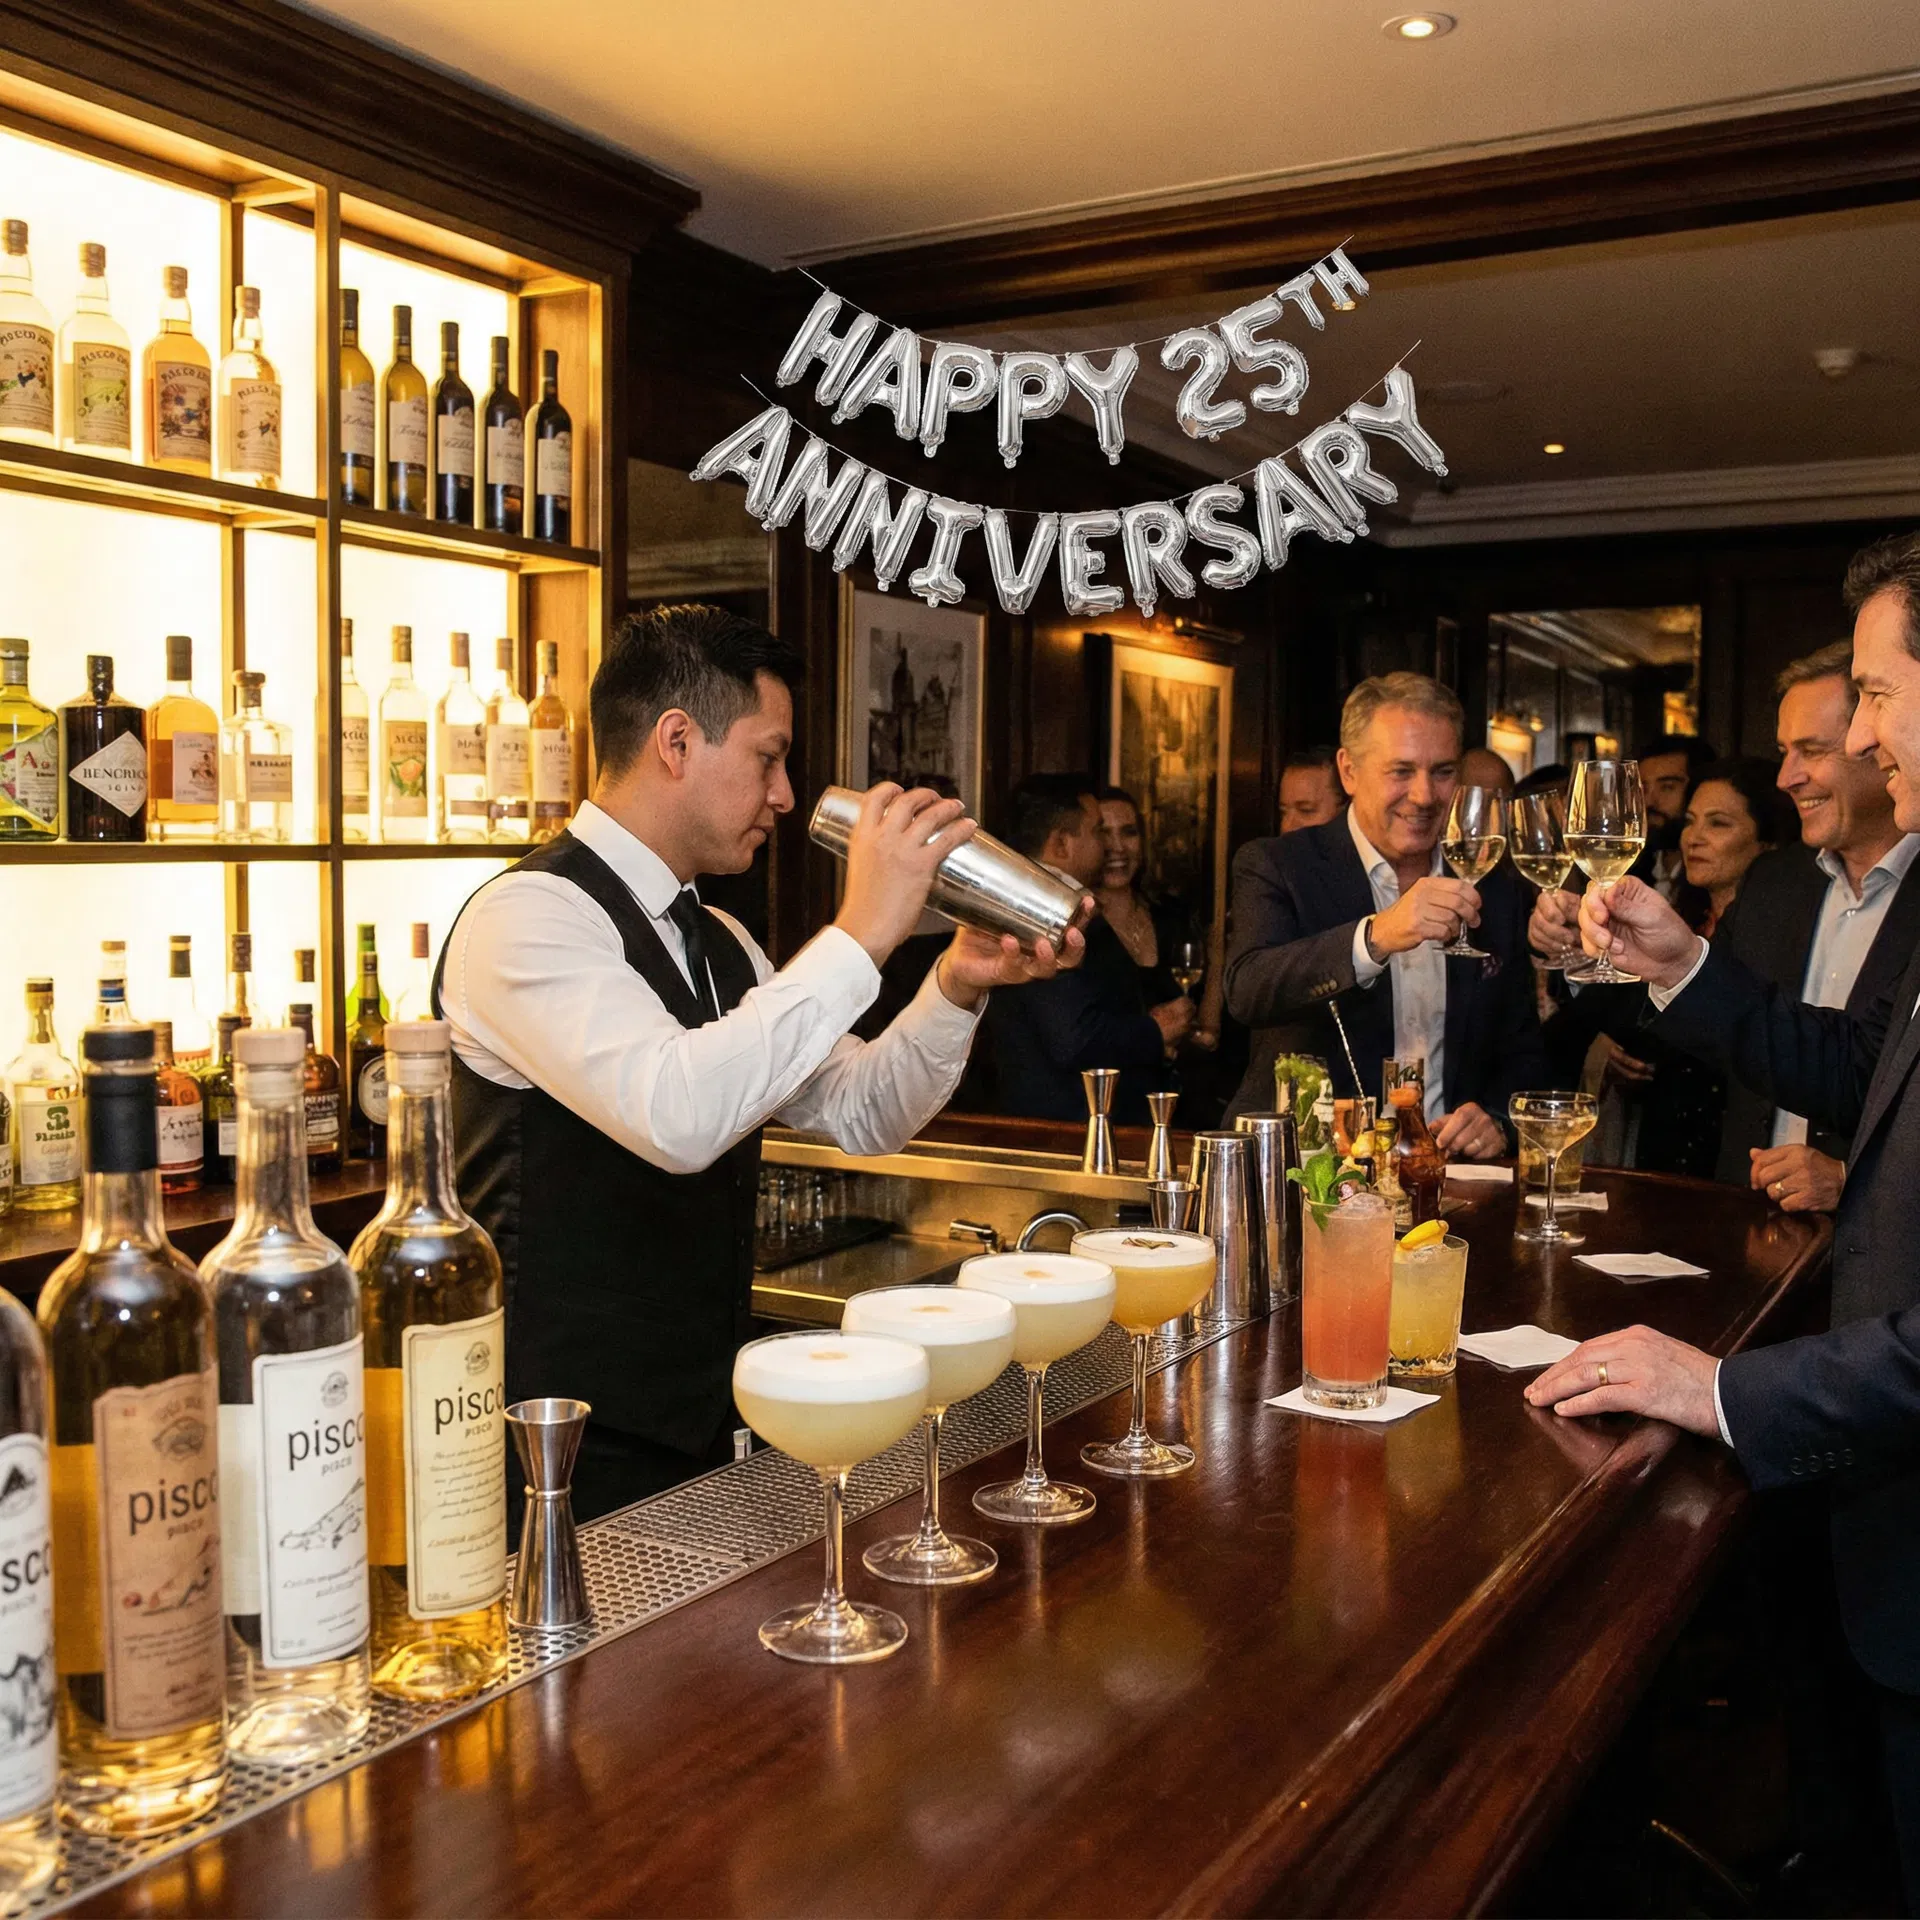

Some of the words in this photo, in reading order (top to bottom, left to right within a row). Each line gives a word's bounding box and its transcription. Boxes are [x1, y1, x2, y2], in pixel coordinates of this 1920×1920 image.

[775, 289, 1140, 467] HAPPY
[1160, 249, 1370, 442] 25TH
[689, 364, 1449, 618] ANNIVERSARY
[435, 1382, 504, 1435] pisco
